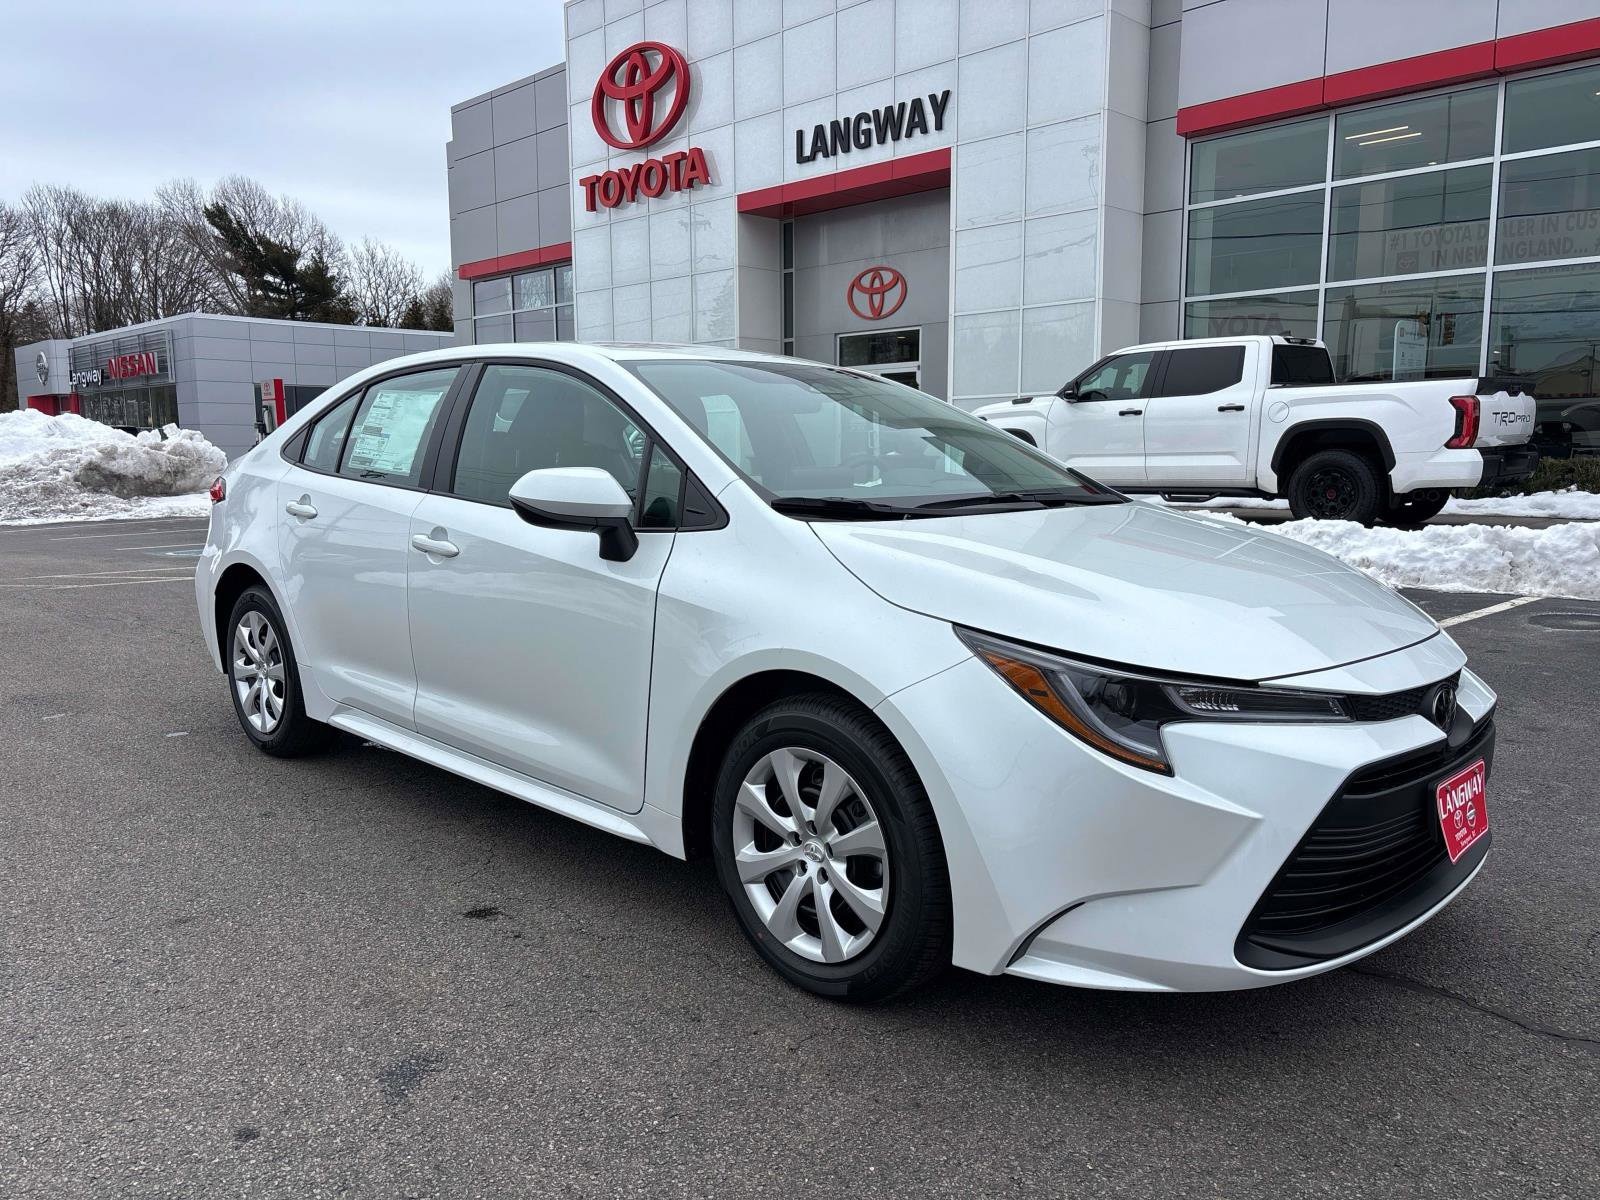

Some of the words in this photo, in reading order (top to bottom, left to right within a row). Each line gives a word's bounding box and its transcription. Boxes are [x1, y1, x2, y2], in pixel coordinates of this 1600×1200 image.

[796, 90, 951, 164] LANGWAY
[579, 147, 710, 212] TOYOTA
[1413, 225, 1473, 247] TOYOTA
[1477, 217, 1534, 241] DALER
[1566, 210, 1600, 231] CUS
[68, 367, 102, 388] Langway
[107, 352, 159, 380] NISSAN
[1492, 411, 1516, 426] TRD
[1440, 773, 1484, 820] LANGWAY
